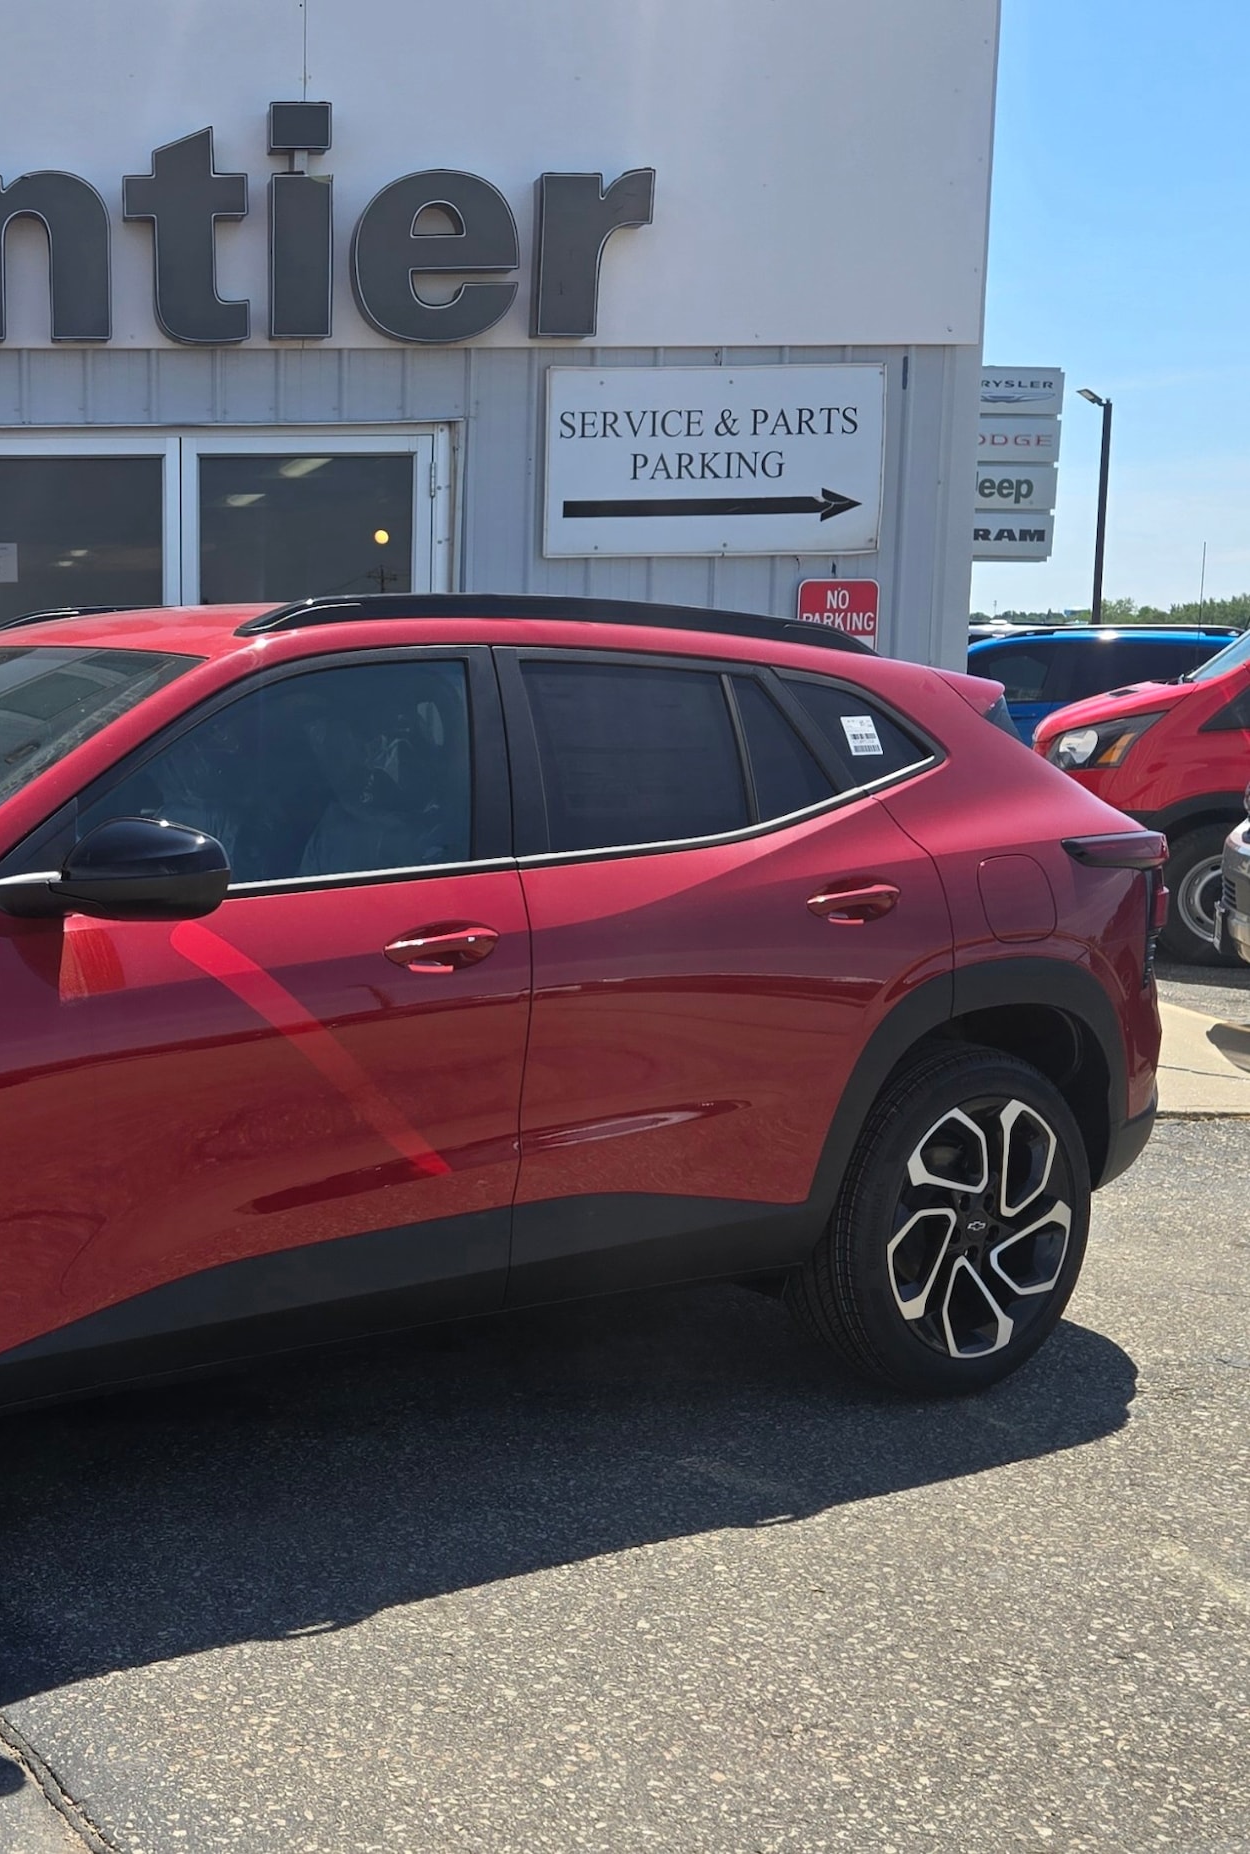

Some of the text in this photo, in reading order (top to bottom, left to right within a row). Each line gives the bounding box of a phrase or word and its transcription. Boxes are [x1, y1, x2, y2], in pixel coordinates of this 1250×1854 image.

[559, 407, 859, 439] SERVICE & PARTS
[629, 451, 786, 480] PARKING
[976, 471, 1034, 504] eep
[973, 528, 1046, 542] RAM
[826, 590, 850, 609] NO
